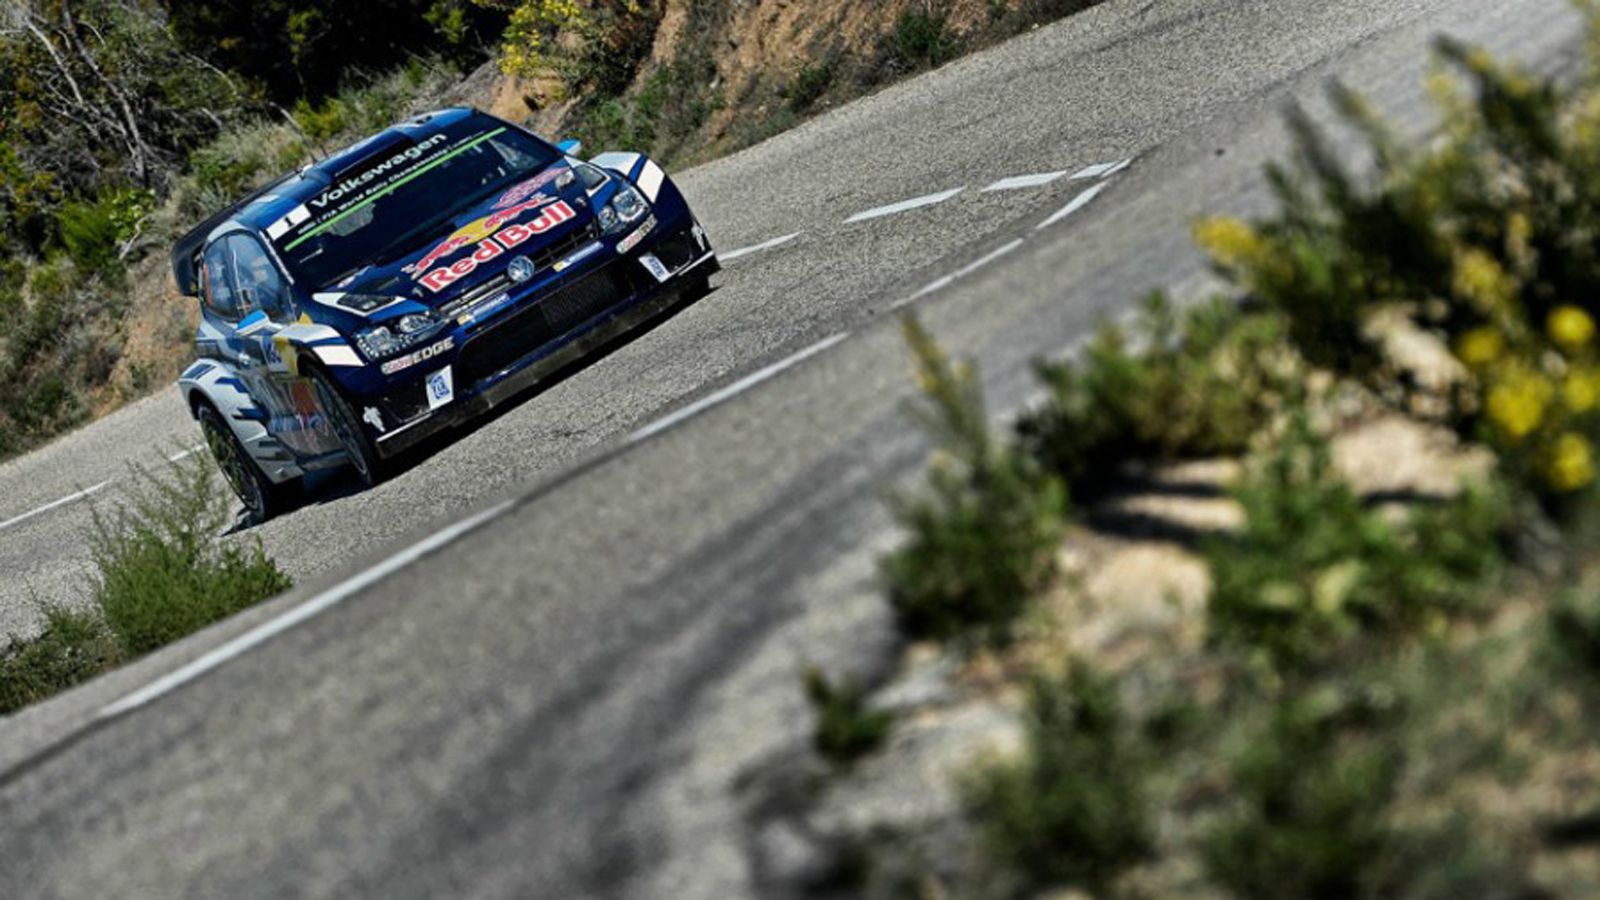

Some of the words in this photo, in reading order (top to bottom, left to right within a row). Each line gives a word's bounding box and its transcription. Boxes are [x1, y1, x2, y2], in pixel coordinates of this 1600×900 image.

[310, 132, 448, 208] Volkswagen
[284, 216, 295, 228] 1
[417, 238, 504, 293] Red
[493, 199, 577, 249] Bull
[412, 335, 455, 365] EDGE
